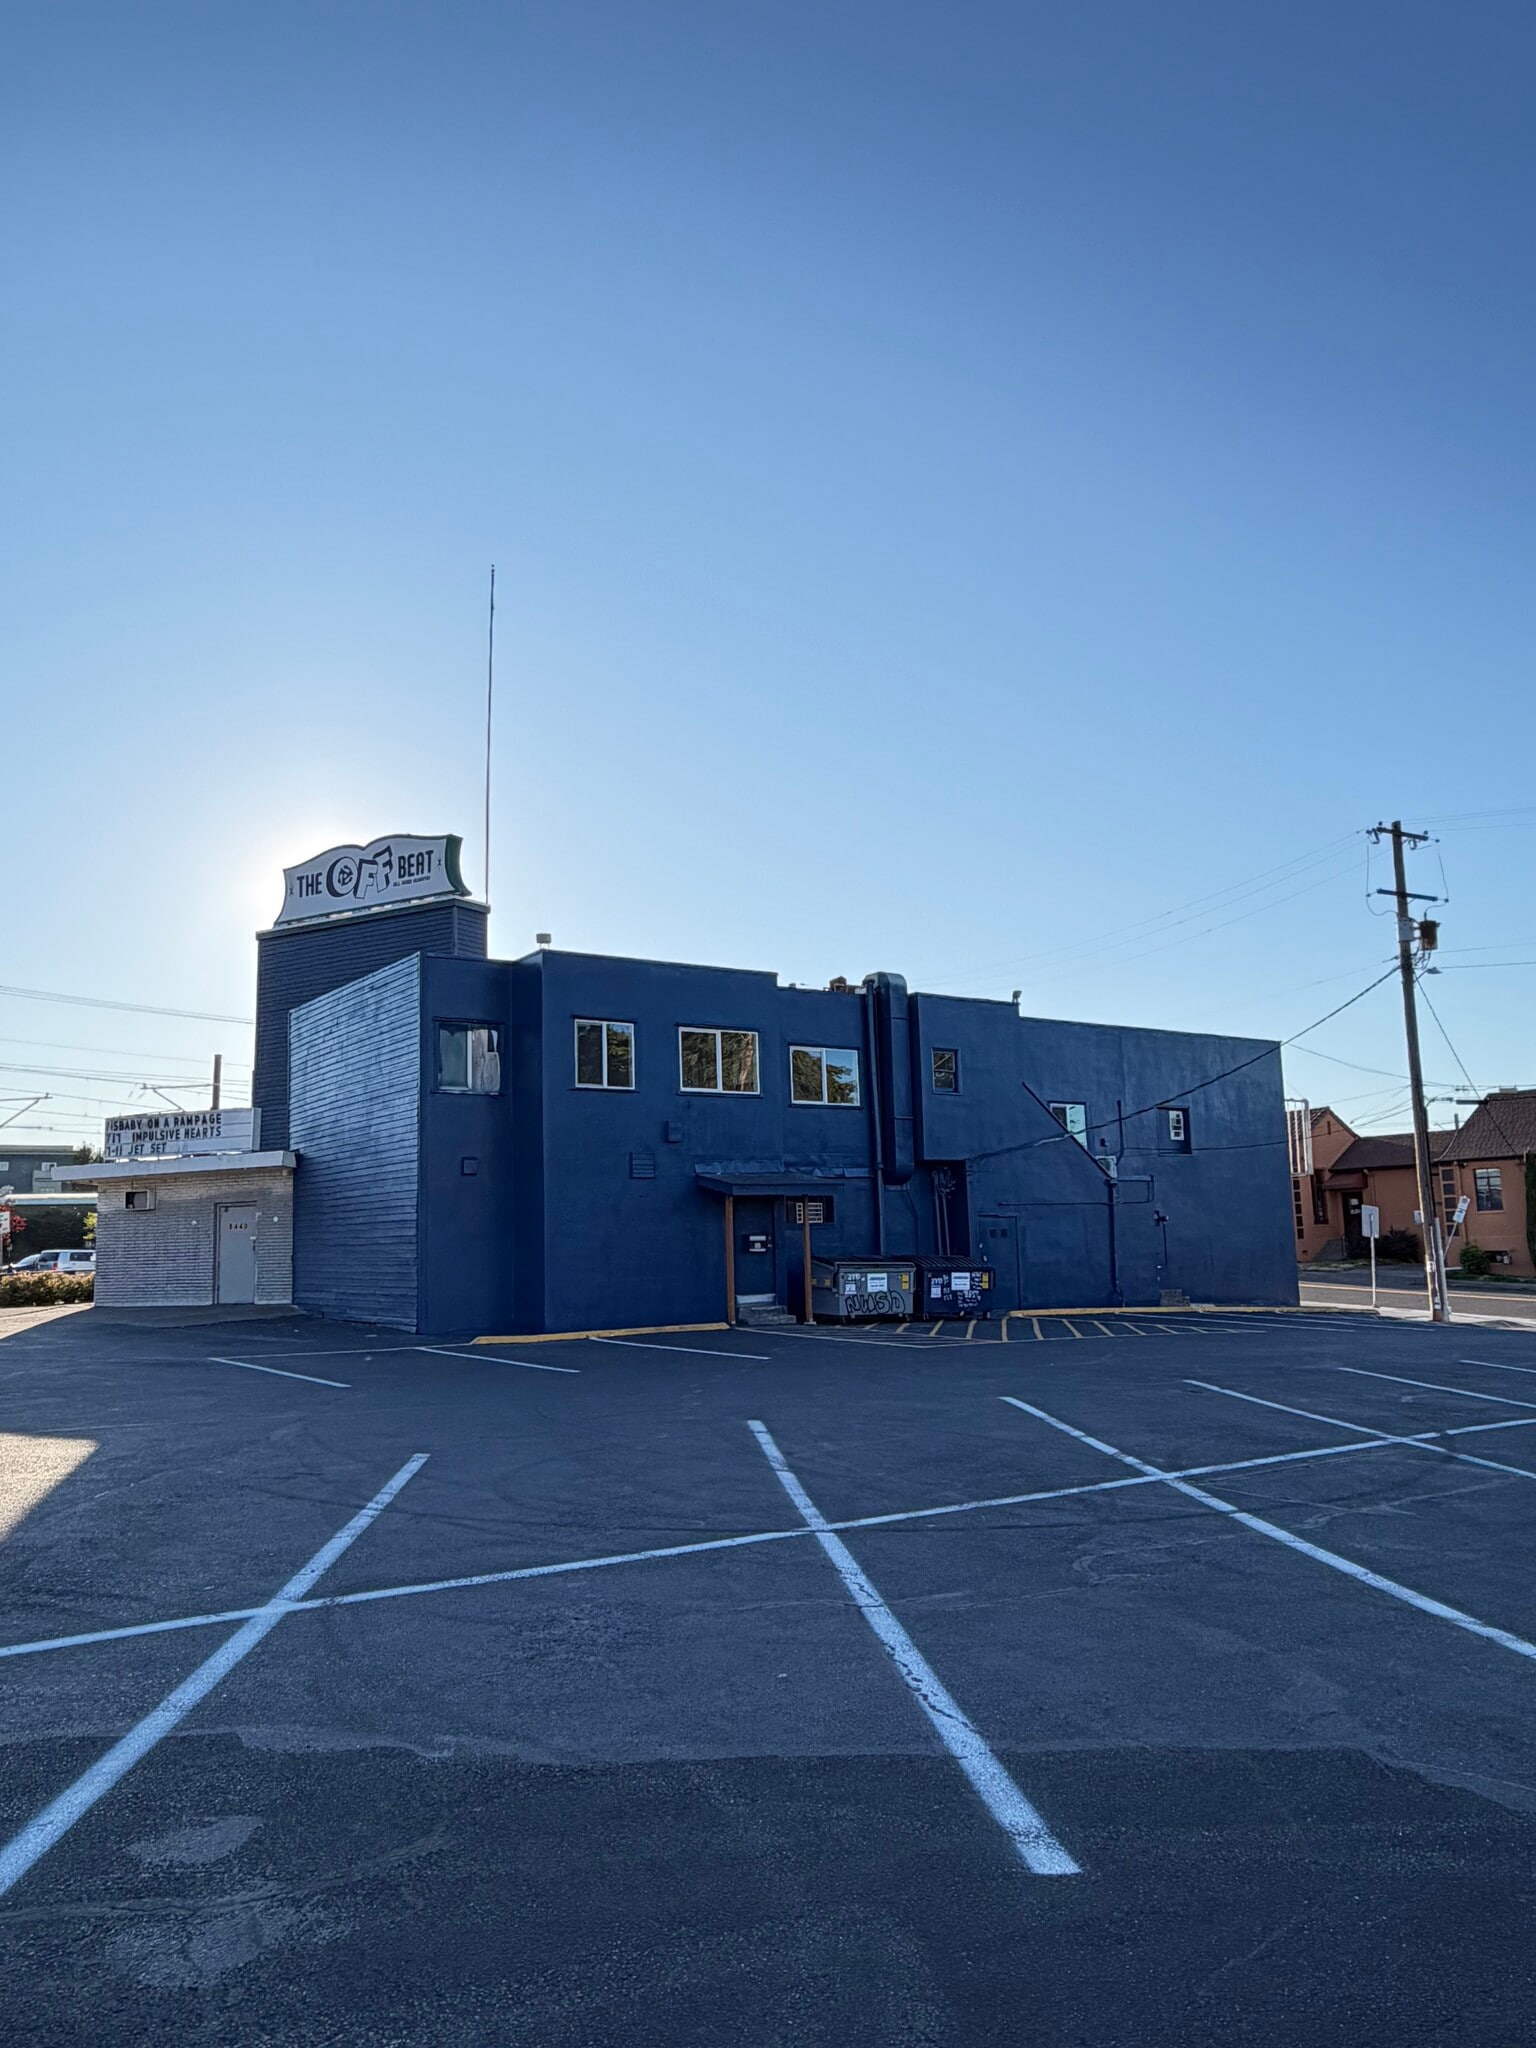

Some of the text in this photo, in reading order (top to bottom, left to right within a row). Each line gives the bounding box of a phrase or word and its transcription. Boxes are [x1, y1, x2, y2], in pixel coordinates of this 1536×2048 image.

[297, 844, 434, 899] THE OFF BEAT
[147, 1117, 160, 1129] ON
[164, 1117, 170, 1128] A
[173, 1113, 222, 1128] RAMPAGE
[132, 1128, 180, 1142] IMPULSIVE
[184, 1125, 222, 1140] HEARTS
[128, 1144, 145, 1155] JET
[150, 1142, 167, 1154] SET
